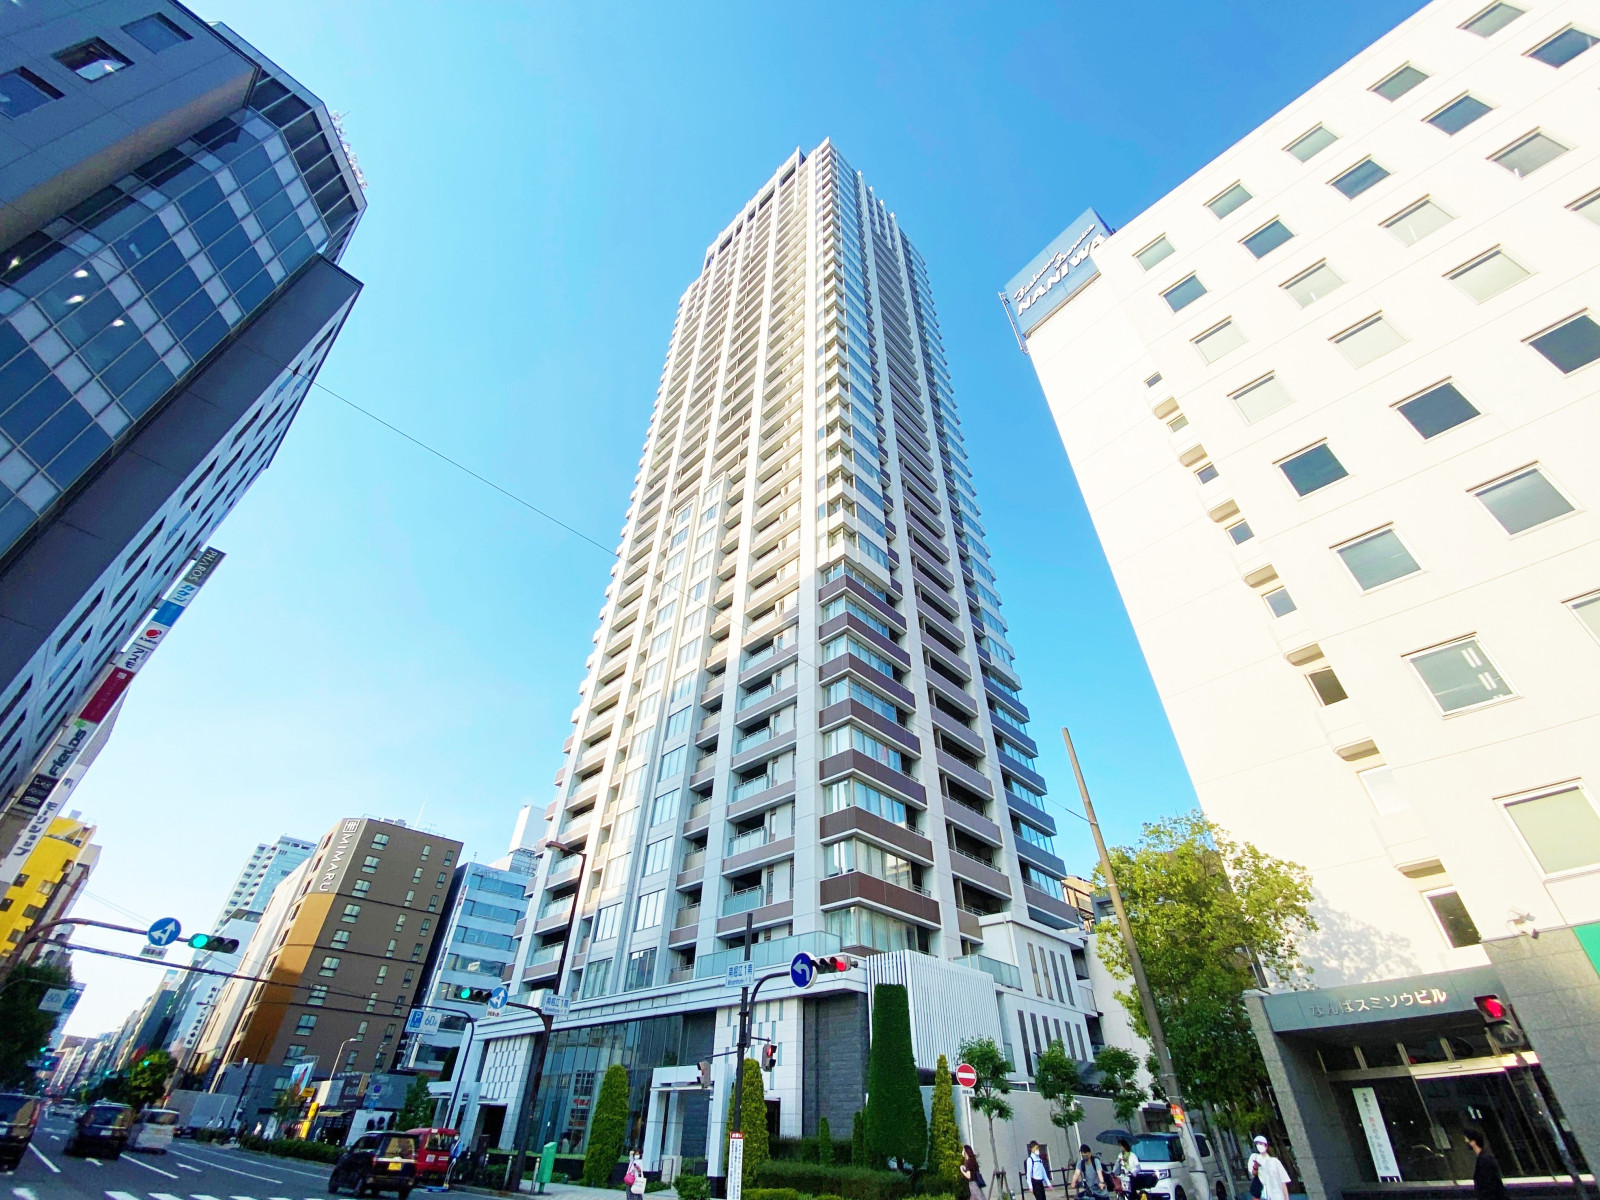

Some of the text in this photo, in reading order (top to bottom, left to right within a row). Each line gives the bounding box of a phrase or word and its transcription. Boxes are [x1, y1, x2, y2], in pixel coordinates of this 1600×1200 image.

[1014, 251, 1061, 302] Fashion
[1017, 233, 1106, 316] NANIWA
[188, 549, 219, 581] PHAROS
[319, 833, 353, 892] MIMARU
[1310, 988, 1447, 1017] なんばスミソウビル
